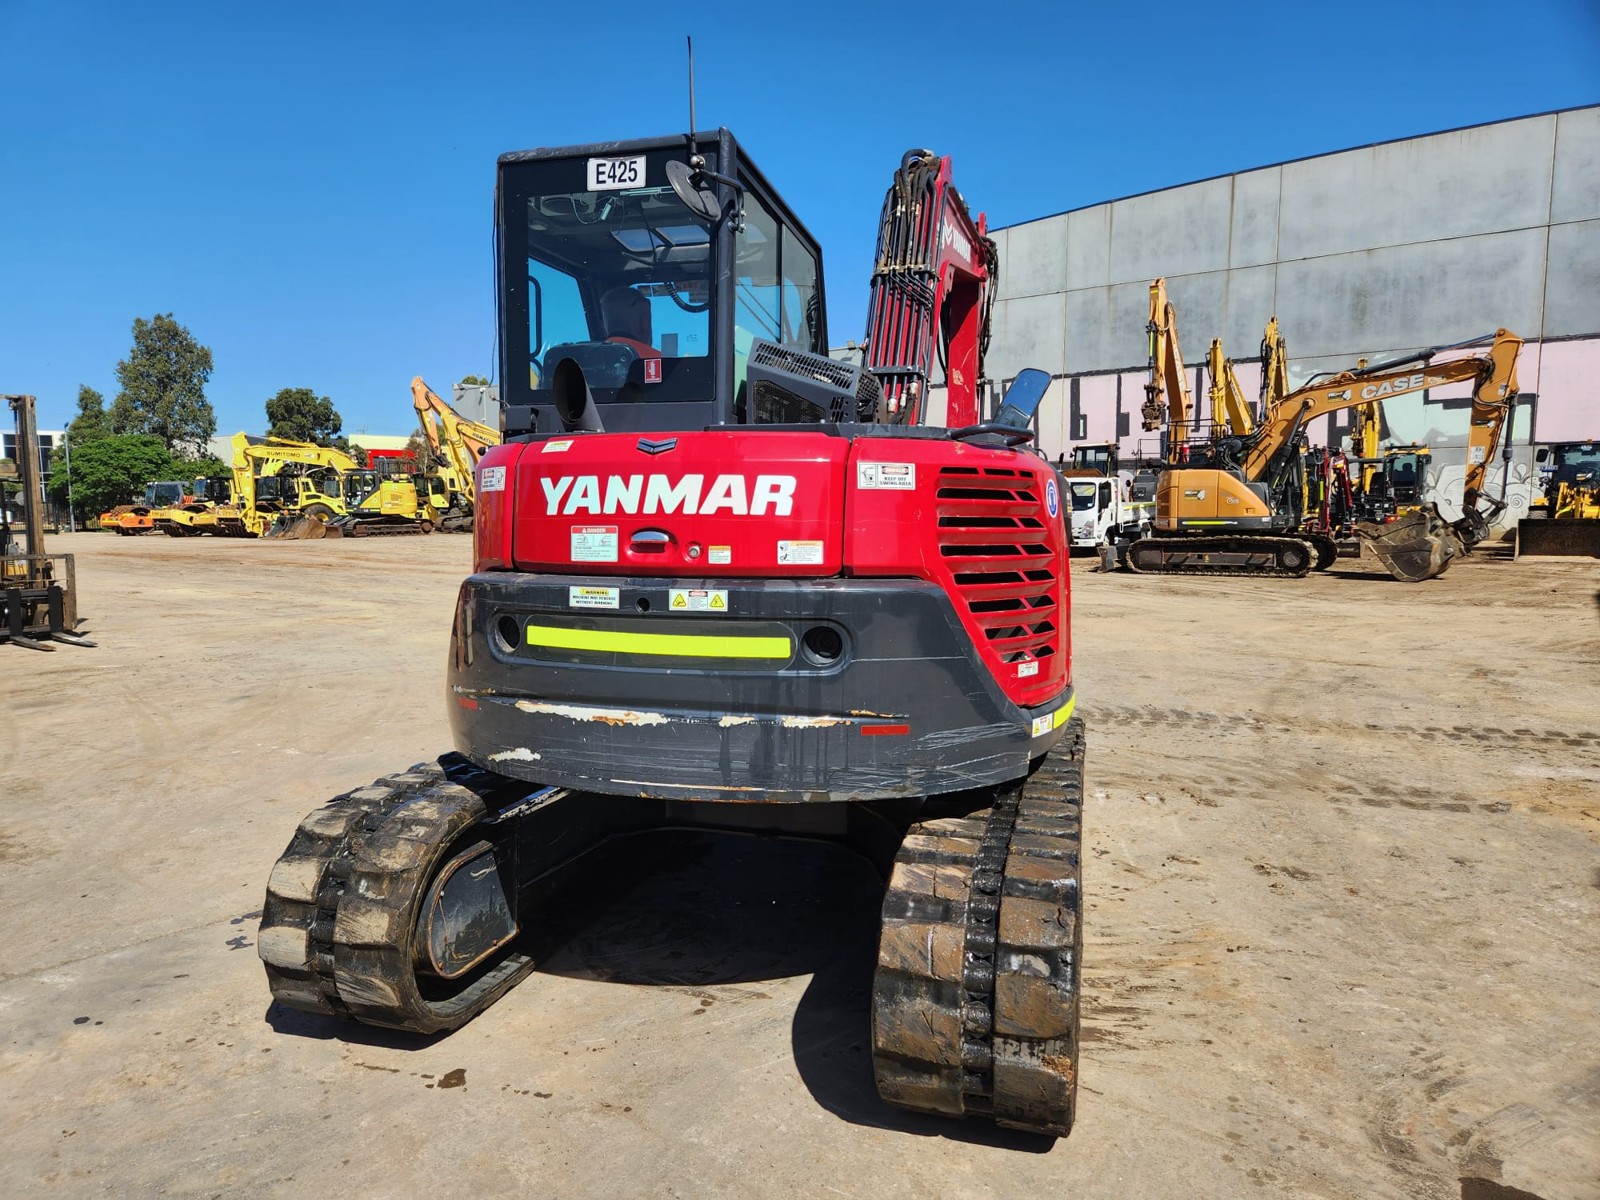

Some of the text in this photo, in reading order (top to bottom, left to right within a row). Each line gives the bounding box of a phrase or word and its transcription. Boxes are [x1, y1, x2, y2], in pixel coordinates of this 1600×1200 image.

[596, 161, 638, 184] E425
[1361, 373, 1424, 399] CASE
[540, 474, 797, 517] YANMAR
